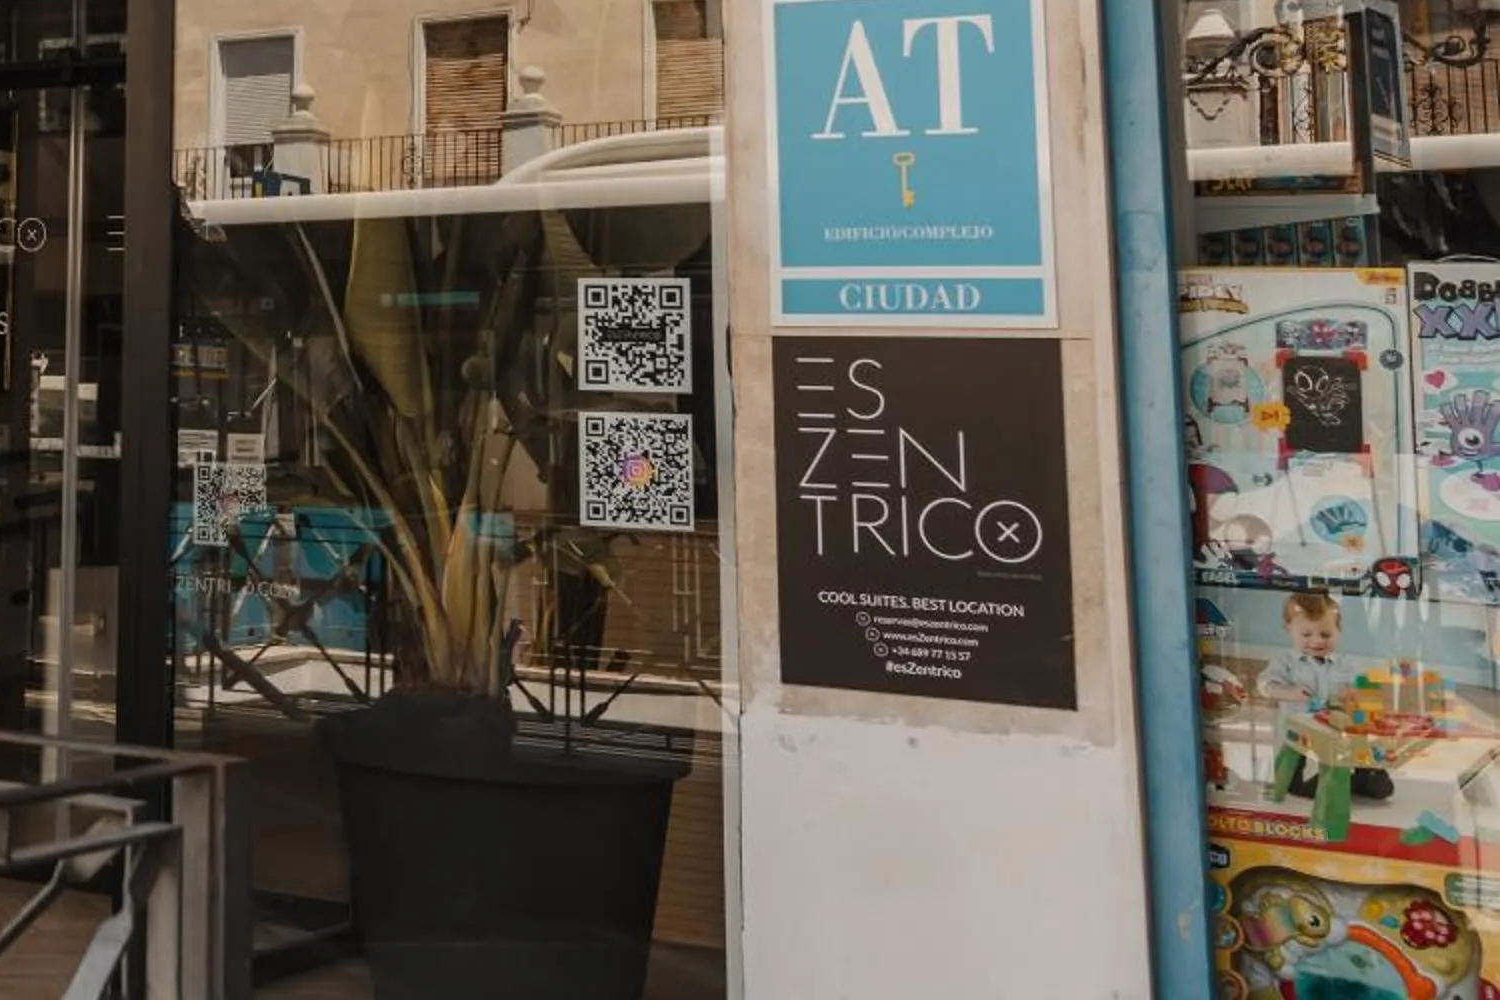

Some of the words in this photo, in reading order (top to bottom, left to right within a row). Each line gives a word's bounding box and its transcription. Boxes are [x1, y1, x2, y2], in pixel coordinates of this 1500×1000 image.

[810, 14, 995, 140] AT
[839, 282, 981, 311] CIUDAD
[1412, 302, 1500, 340] XX
[795, 357, 886, 420] ES
[797, 426, 967, 493] ZEN
[799, 493, 1044, 564] TRICO
[817, 590, 857, 605] COOL
[912, 597, 947, 612] BEST
[949, 600, 1026, 617] LOCATION
